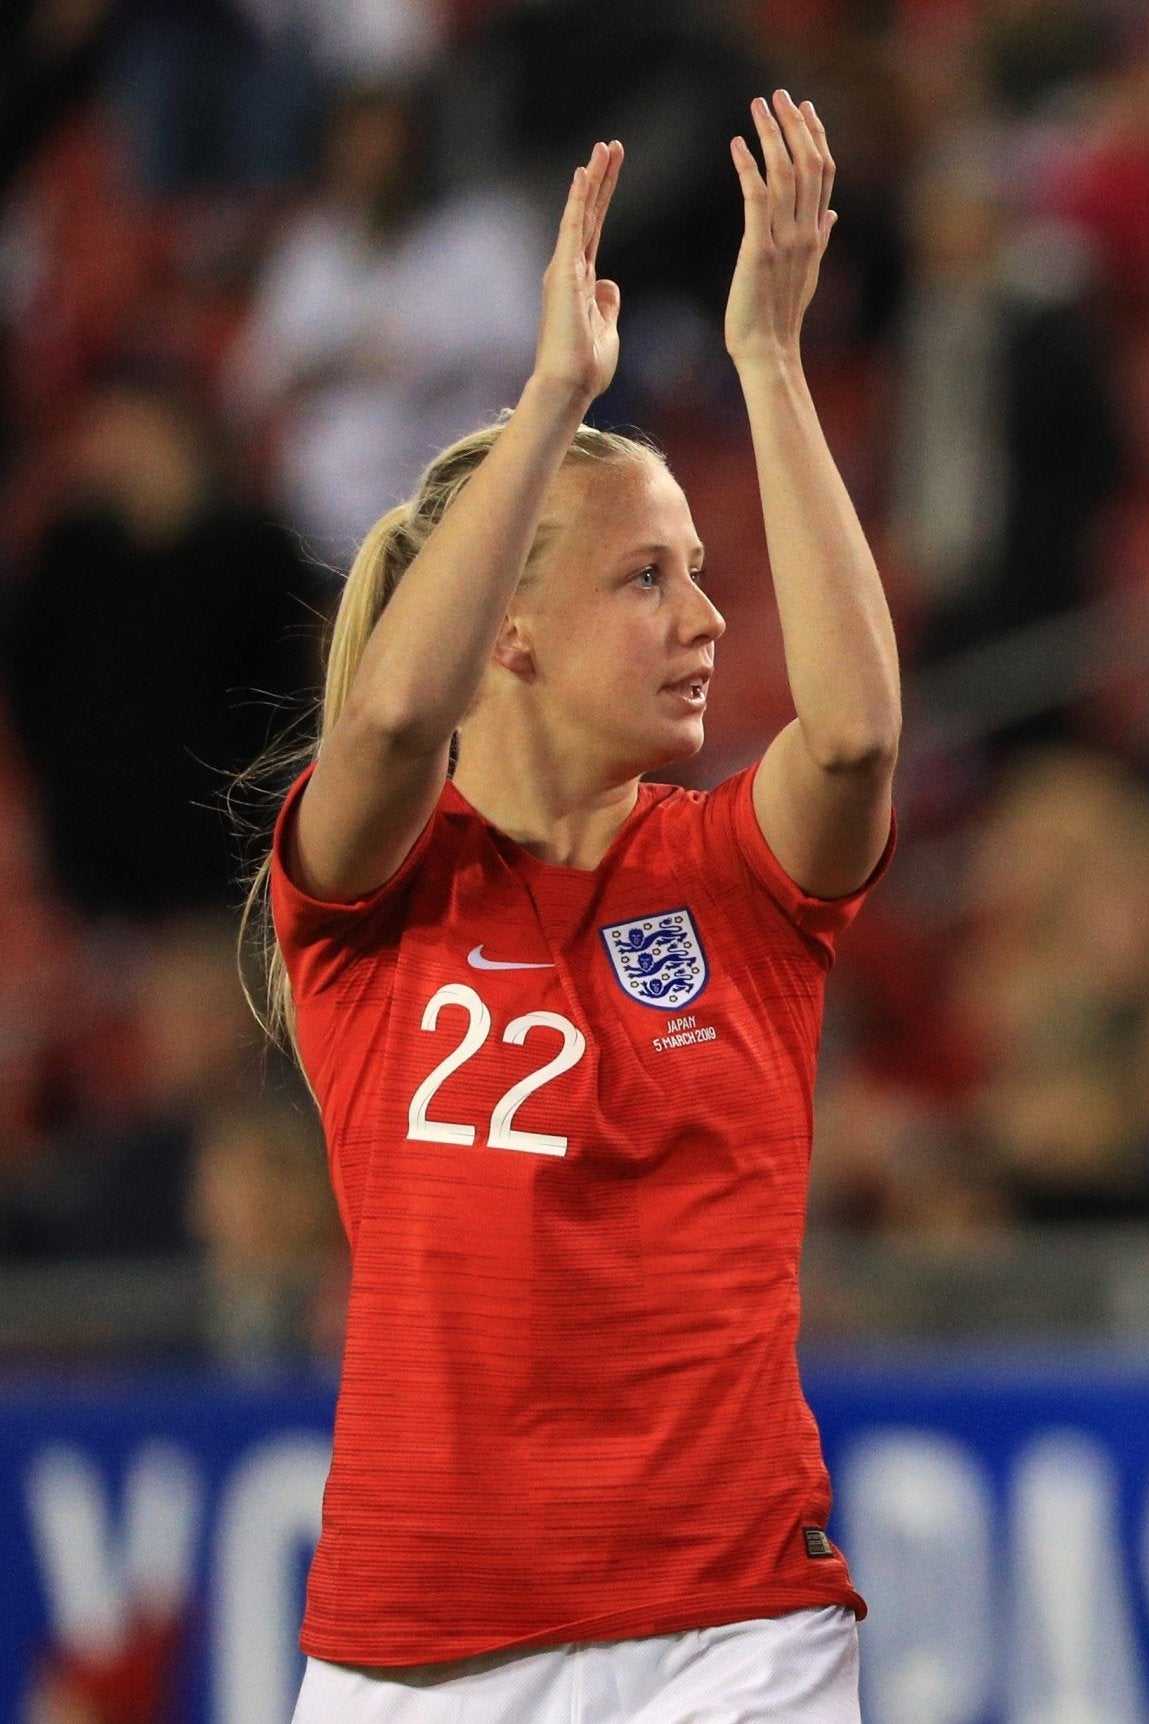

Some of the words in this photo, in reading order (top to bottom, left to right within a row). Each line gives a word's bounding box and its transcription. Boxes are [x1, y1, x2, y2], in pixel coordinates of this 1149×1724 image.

[667, 1015, 696, 1033] JAPAN
[653, 1038, 662, 1052] 5
[661, 1031, 697, 1048] MARCH
[695, 1026, 716, 1042] 2019
[406, 983, 586, 1157] 22
